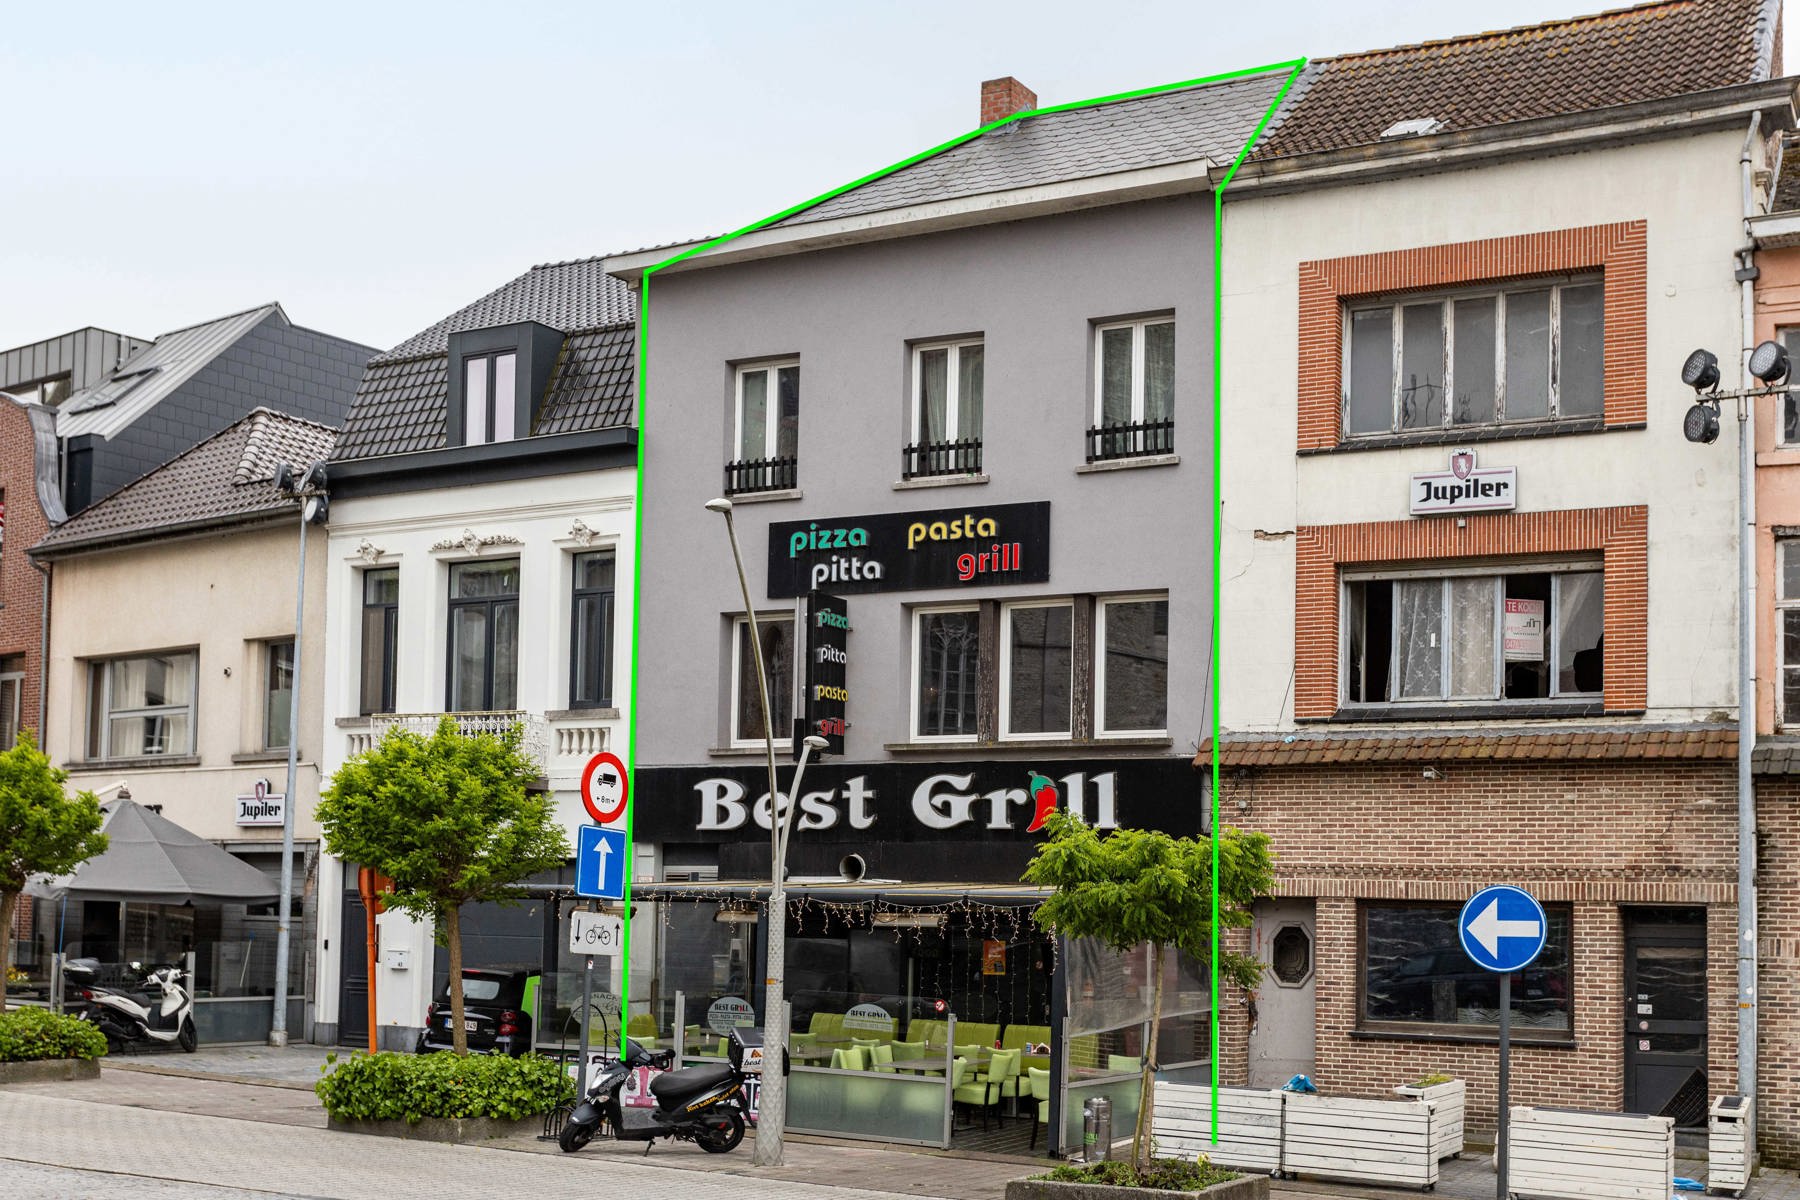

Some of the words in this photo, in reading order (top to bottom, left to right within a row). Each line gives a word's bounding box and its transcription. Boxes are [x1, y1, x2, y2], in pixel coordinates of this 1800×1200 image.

[1418, 479, 1509, 505] Jupiler
[789, 523, 869, 558] pizza
[907, 514, 997, 550] pasta
[811, 554, 882, 590] pitta
[956, 543, 1020, 581] grill
[818, 608, 849, 629] pizza
[819, 644, 847, 664] pitta
[817, 685, 849, 702] pasta
[819, 718, 845, 736] grill
[240, 802, 281, 820] Jupiler
[693, 775, 879, 832] Best
